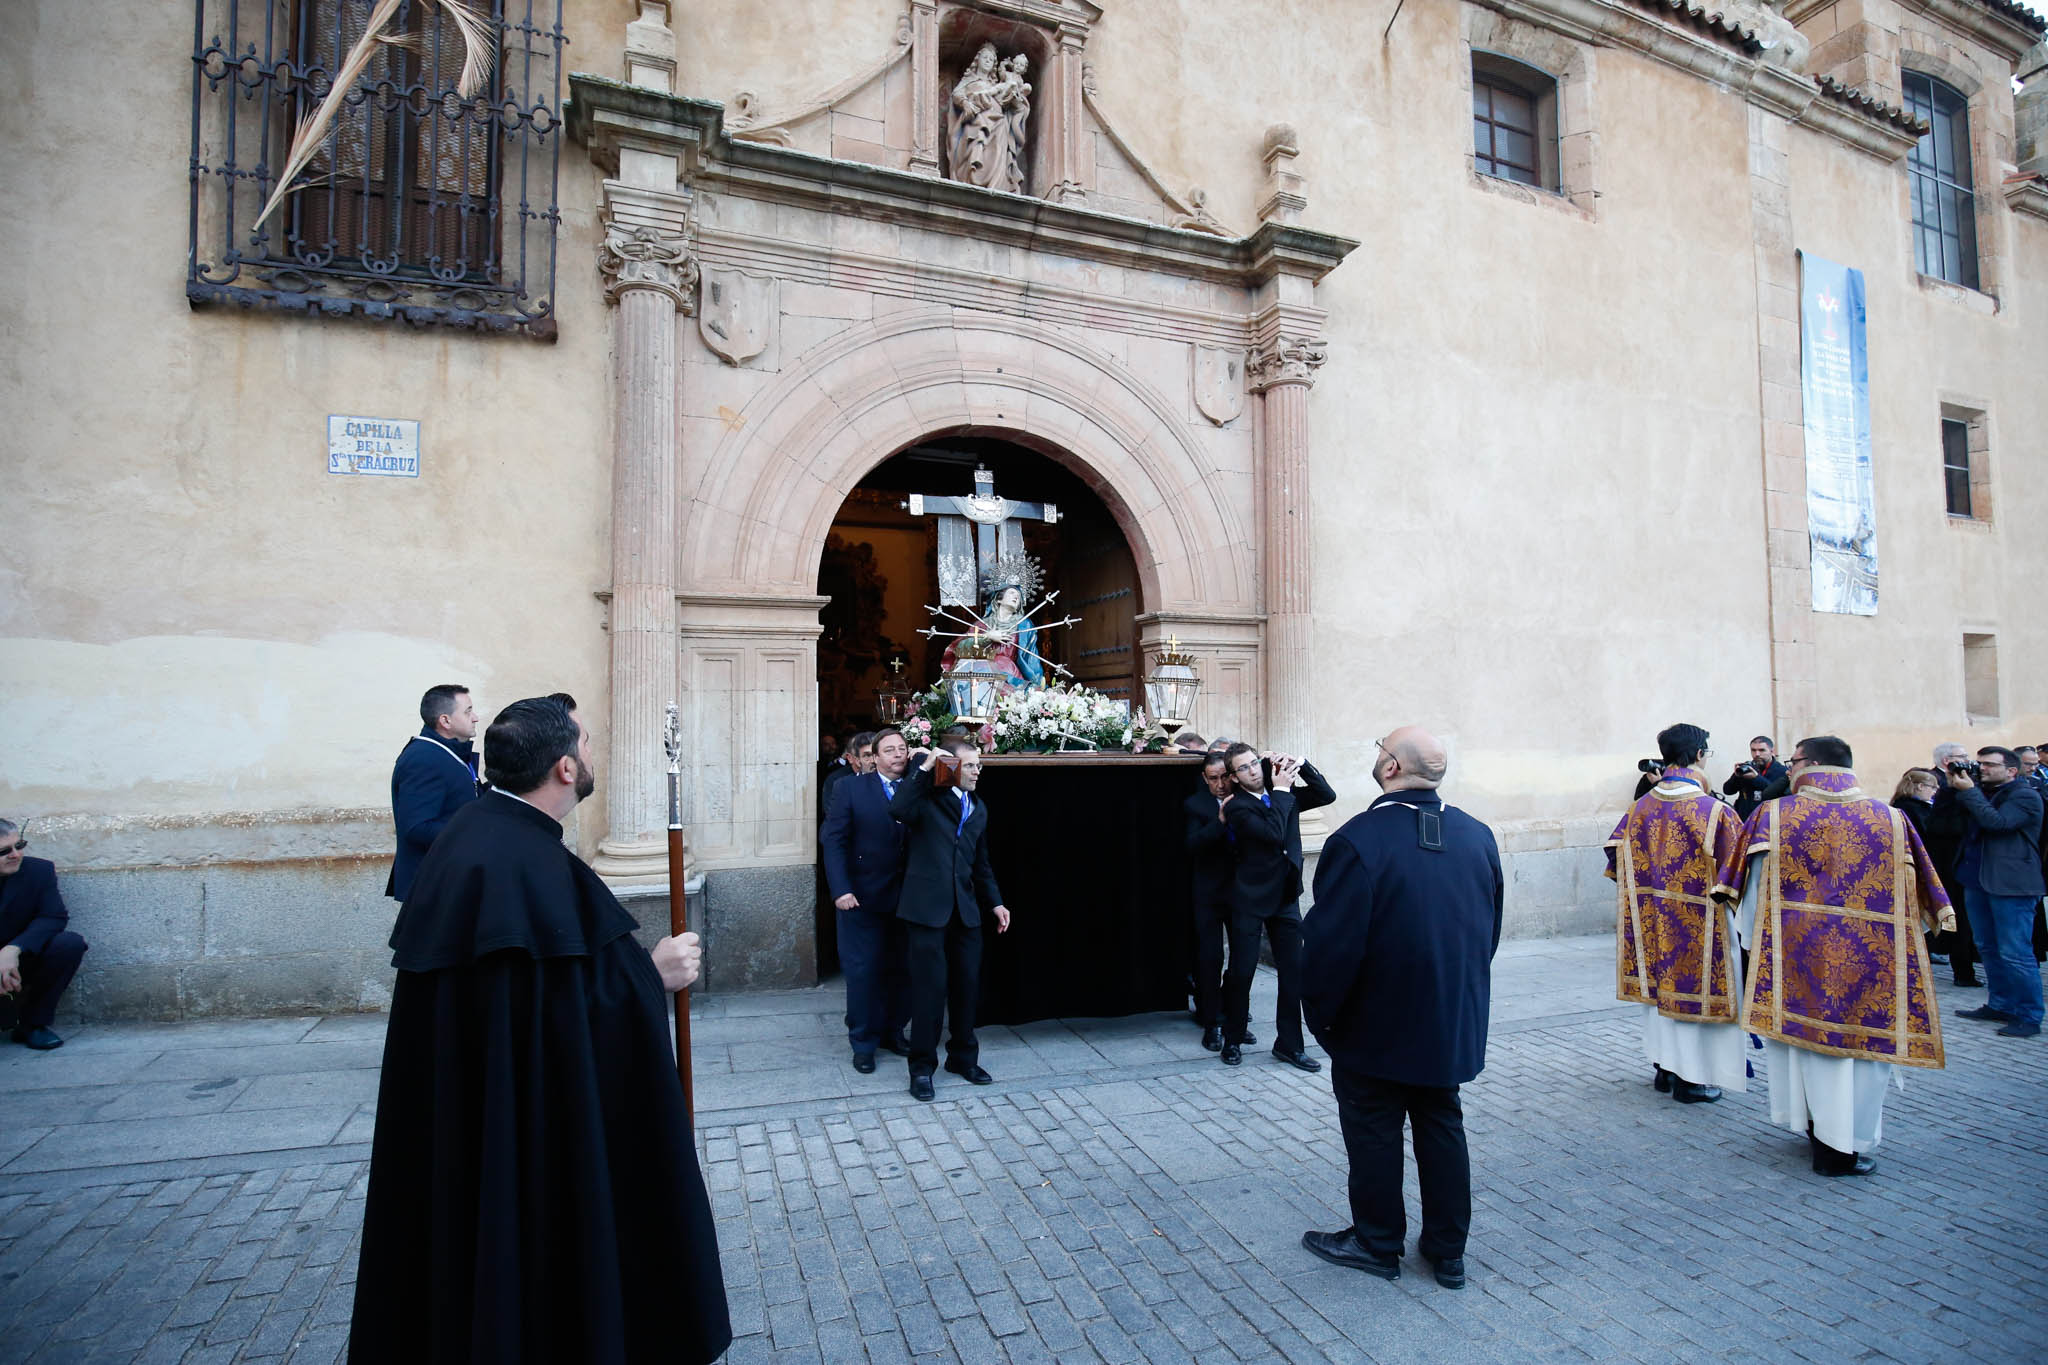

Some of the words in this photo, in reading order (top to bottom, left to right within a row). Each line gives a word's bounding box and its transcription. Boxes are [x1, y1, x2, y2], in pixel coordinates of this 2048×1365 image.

[346, 422, 402, 439] CAPILLA
[357, 440, 373, 452] DE
[376, 441, 392, 453] LA
[347, 454, 415, 472] VERACRUZ
